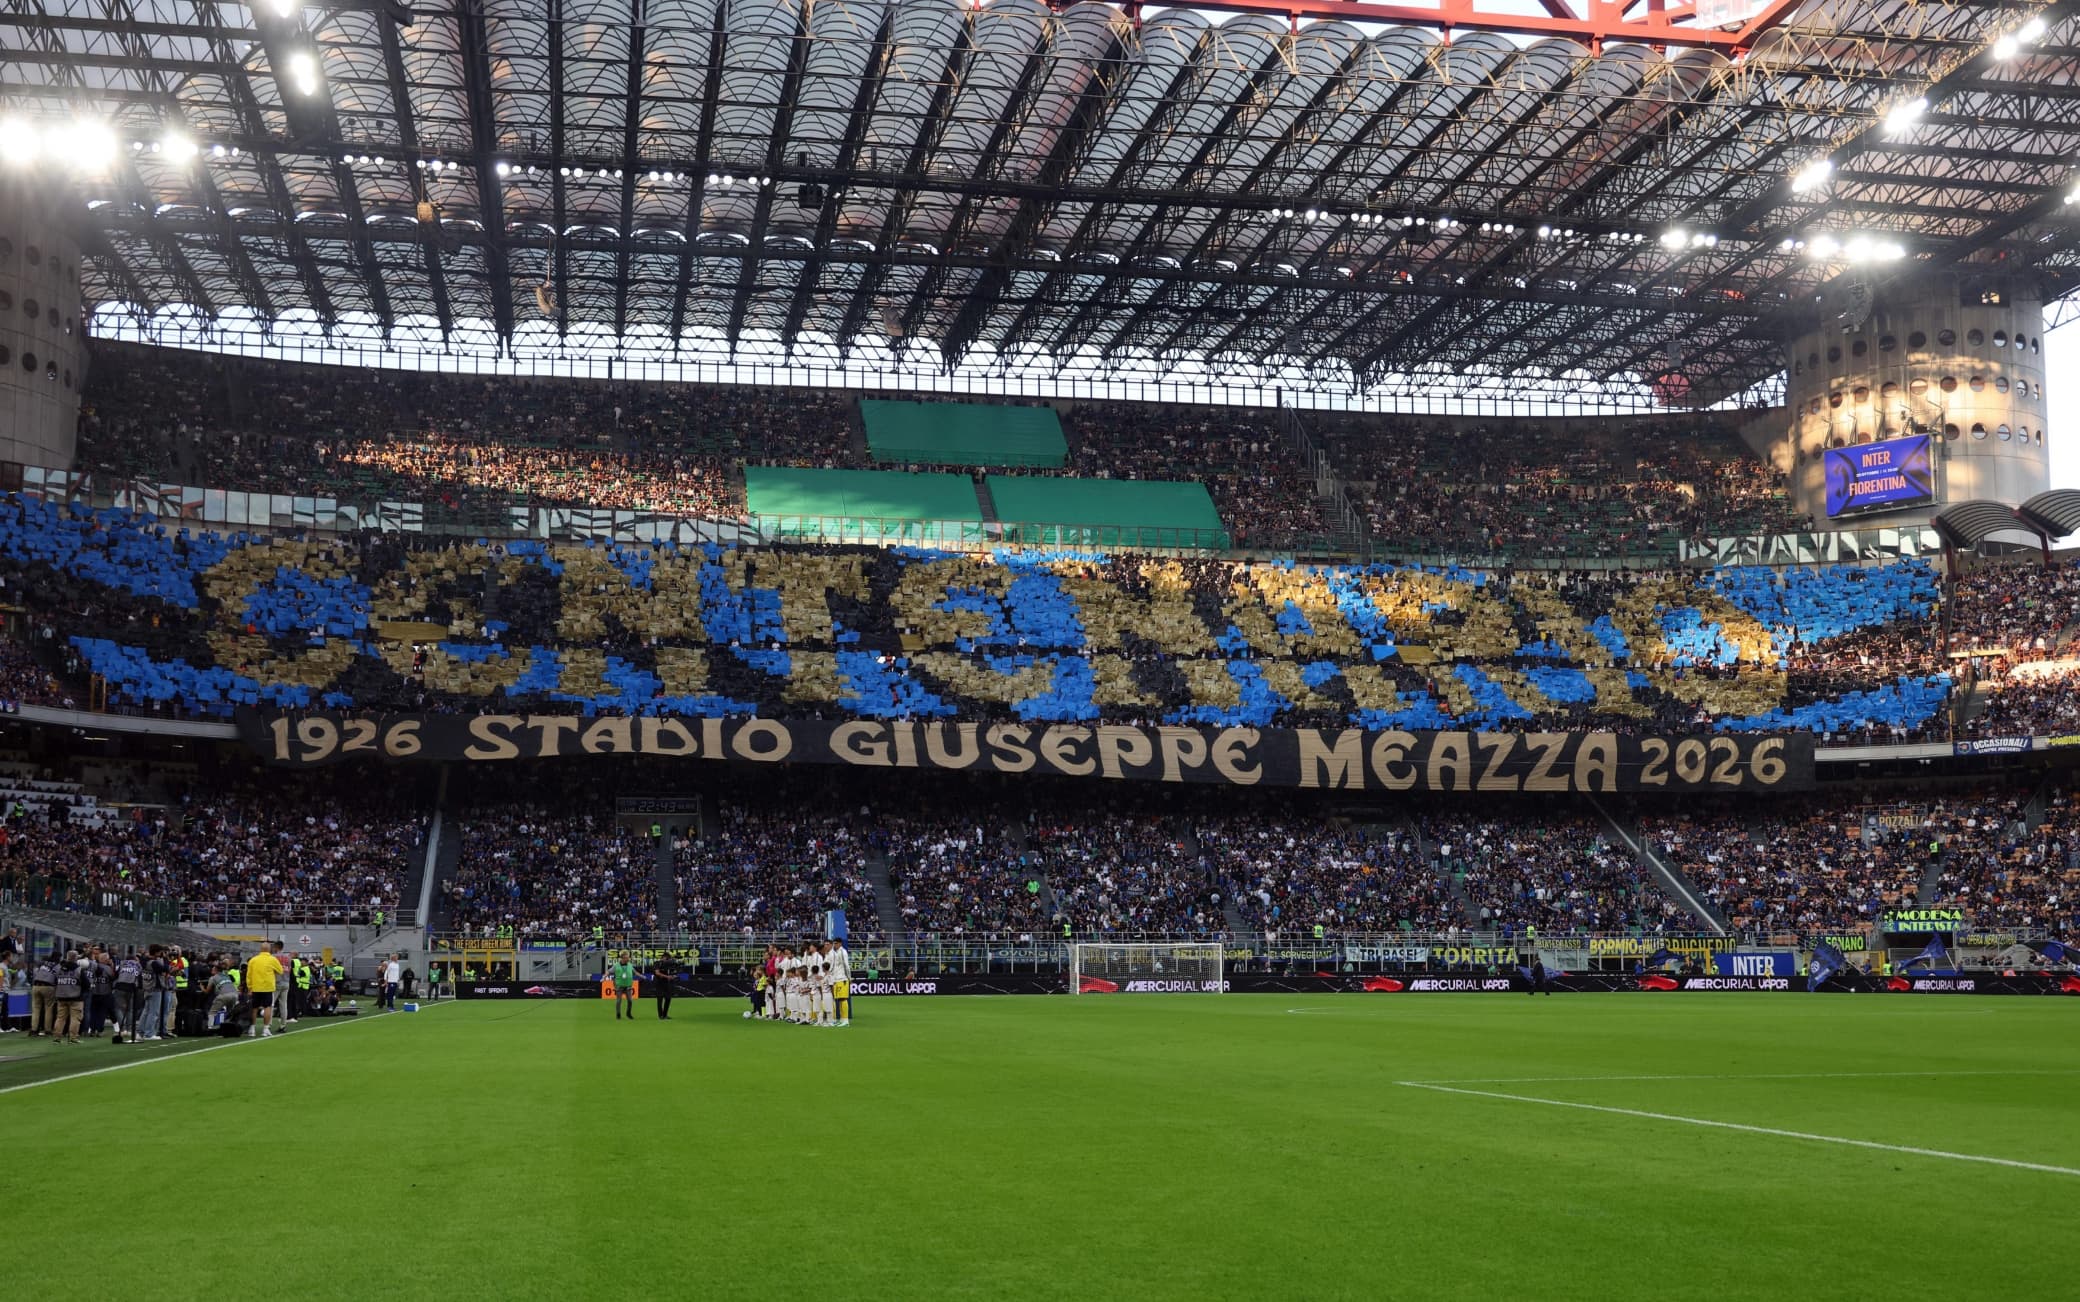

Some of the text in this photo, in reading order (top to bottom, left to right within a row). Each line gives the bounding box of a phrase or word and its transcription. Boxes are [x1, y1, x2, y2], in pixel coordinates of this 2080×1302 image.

[1862, 451, 1891, 467] INTER
[1849, 475, 1907, 496] FIORENTINA
[1973, 738, 2028, 750] OCCASIONALI
[270, 716, 1786, 791] 1926 STADIO GIUSEPPE MEAZZA 2026
[1896, 910, 1962, 921] MODENA
[454, 939, 465, 949] THE
[465, 939, 480, 949] FIRST
[1589, 938, 1638, 955] BORMIO
[1823, 936, 1865, 951] EGNANO
[999, 950, 1068, 958] OVUNQUE
[1433, 947, 1519, 965] TORRITA
[1732, 956, 1775, 976] INTER
[905, 983, 936, 994] VAPOR
[1124, 981, 1230, 992] MERCURIAL VAPOR
[1409, 979, 1510, 990] MERCURIAL VAPOR
[1684, 979, 1788, 990] MERCURIAL VAPOR
[1913, 980, 1975, 990] MERCURIAL VAPOR
